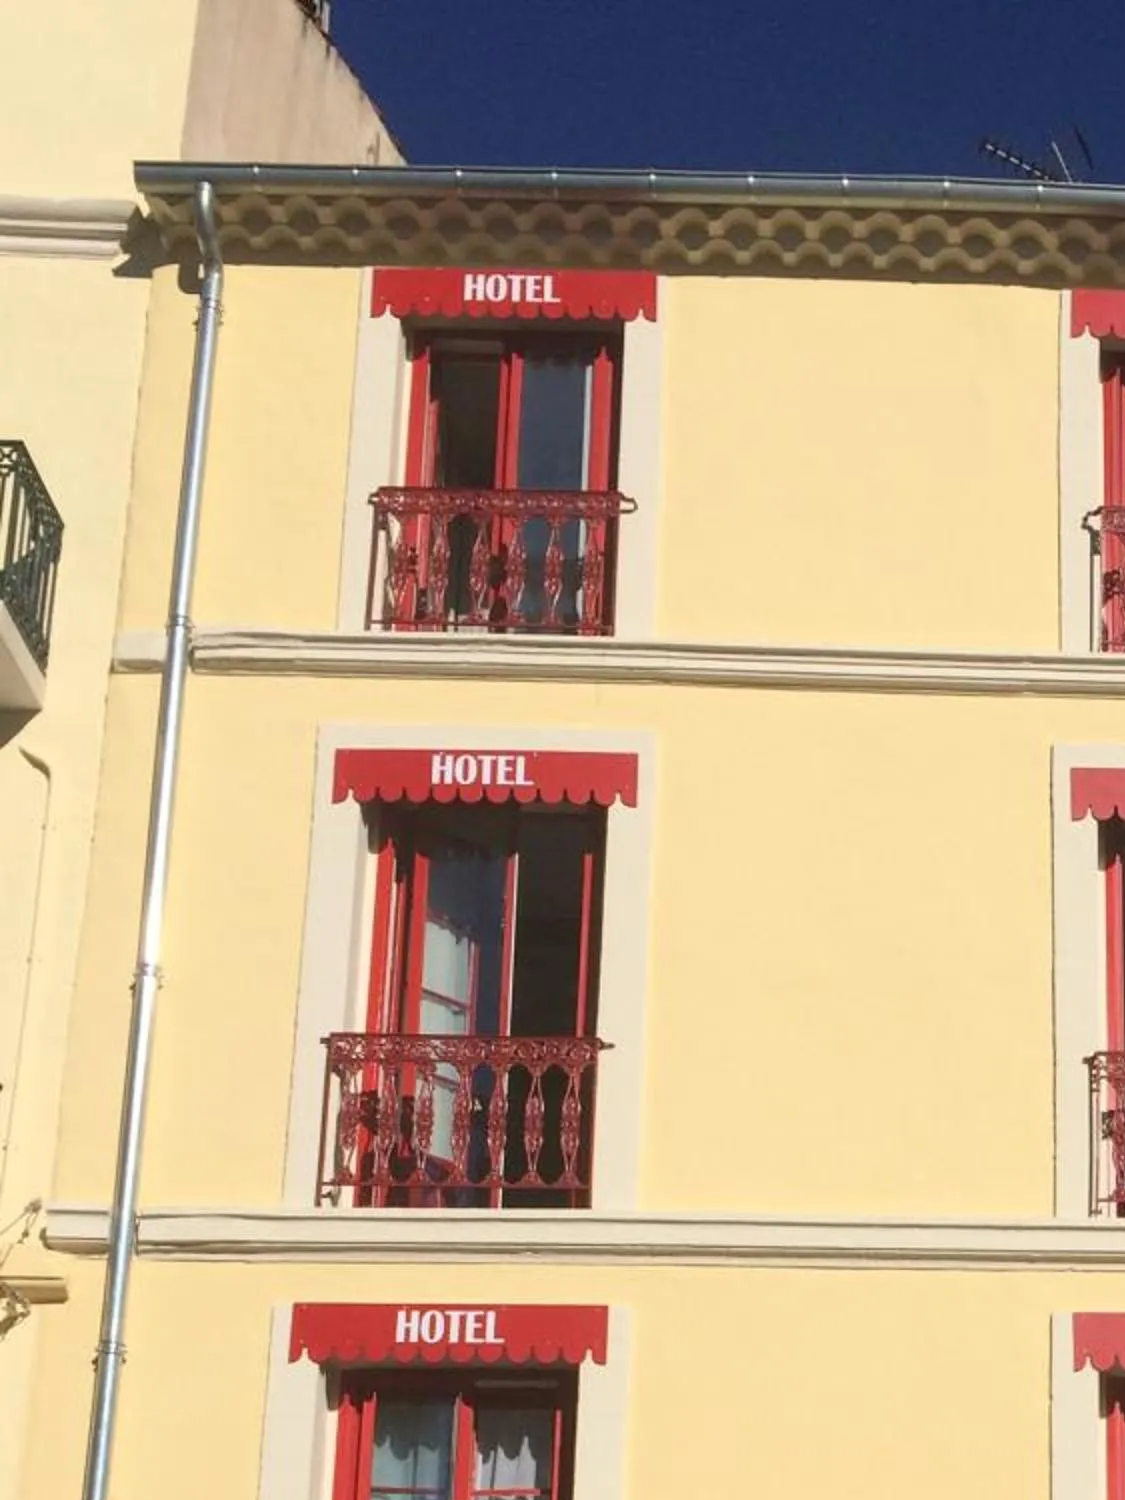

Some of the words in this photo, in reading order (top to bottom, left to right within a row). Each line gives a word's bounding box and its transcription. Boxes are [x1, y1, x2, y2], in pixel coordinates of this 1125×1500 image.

[463, 273, 561, 303] HOTEL
[431, 753, 535, 785] HOTEL
[395, 1309, 505, 1344] HOTEL
